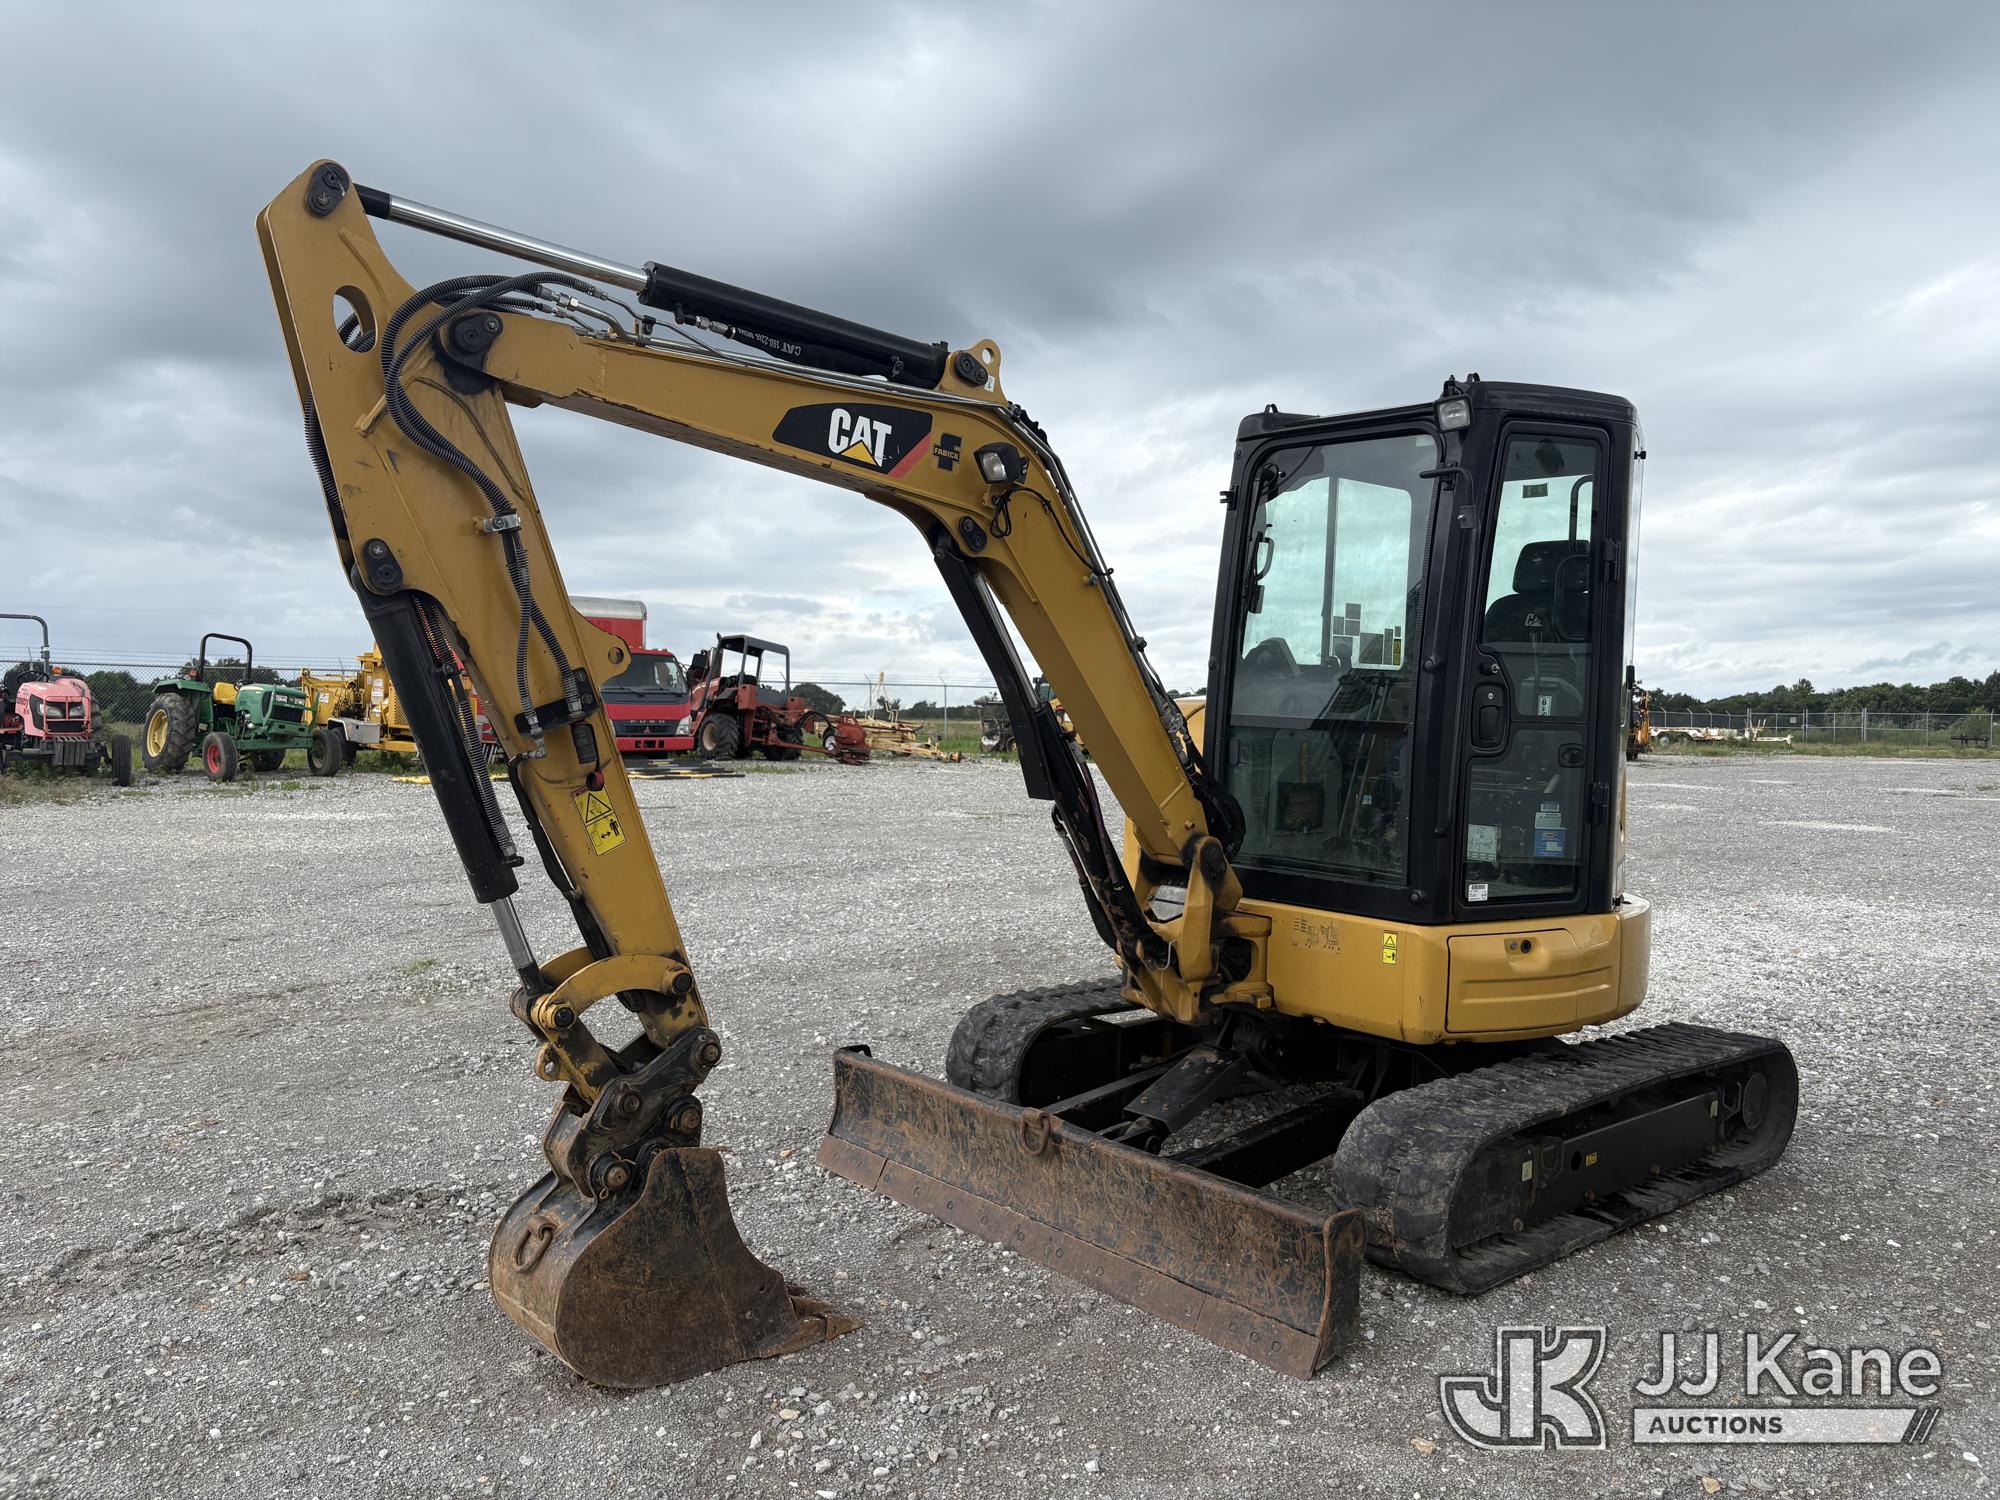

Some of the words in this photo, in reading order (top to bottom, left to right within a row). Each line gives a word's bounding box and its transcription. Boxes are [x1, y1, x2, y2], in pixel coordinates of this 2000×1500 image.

[781, 342, 802, 357] CAT
[827, 408, 893, 468] CAT
[933, 445, 960, 461] FABICK
